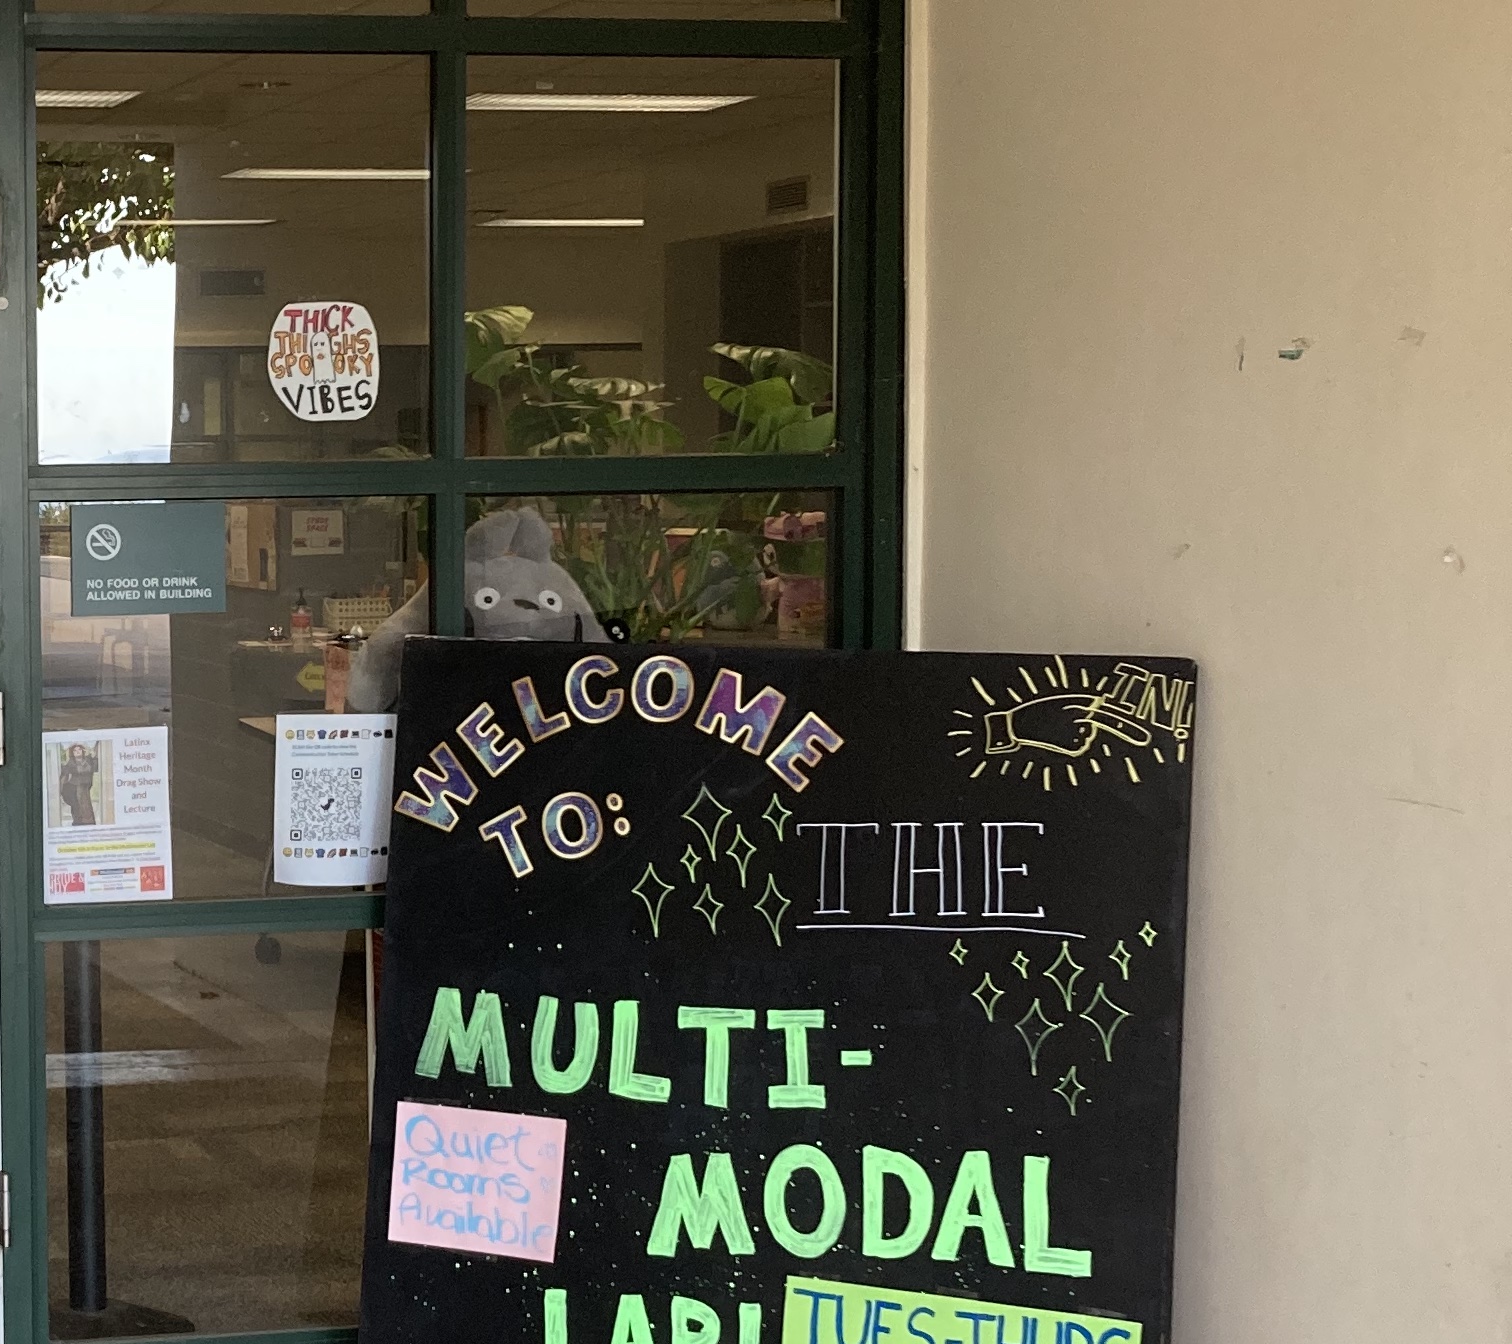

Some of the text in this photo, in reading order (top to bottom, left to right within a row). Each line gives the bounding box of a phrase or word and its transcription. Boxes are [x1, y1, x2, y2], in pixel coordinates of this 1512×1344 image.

[284, 304, 354, 333] THICK
[281, 380, 373, 415] VIBES
[86, 577, 198, 589] NO FOOD OR DRINK
[86, 588, 212, 601] ALLOWED IN BUILDING
[119, 751, 156, 761] Heritage
[123, 738, 151, 747] Latinx
[394, 655, 845, 832] WELCOME
[116, 777, 162, 788] Drag Show
[123, 764, 152, 773] Month
[123, 804, 155, 813] Lecture
[131, 791, 147, 799] and
[478, 791, 631, 879] TO:
[796, 822, 1045, 918] THE
[415, 987, 873, 1110] MULTI-
[404, 1114, 535, 1172] Quiet
[400, 1157, 531, 1204] Rooms
[398, 1192, 554, 1252] Available
[646, 1143, 1092, 1278] MODAL
